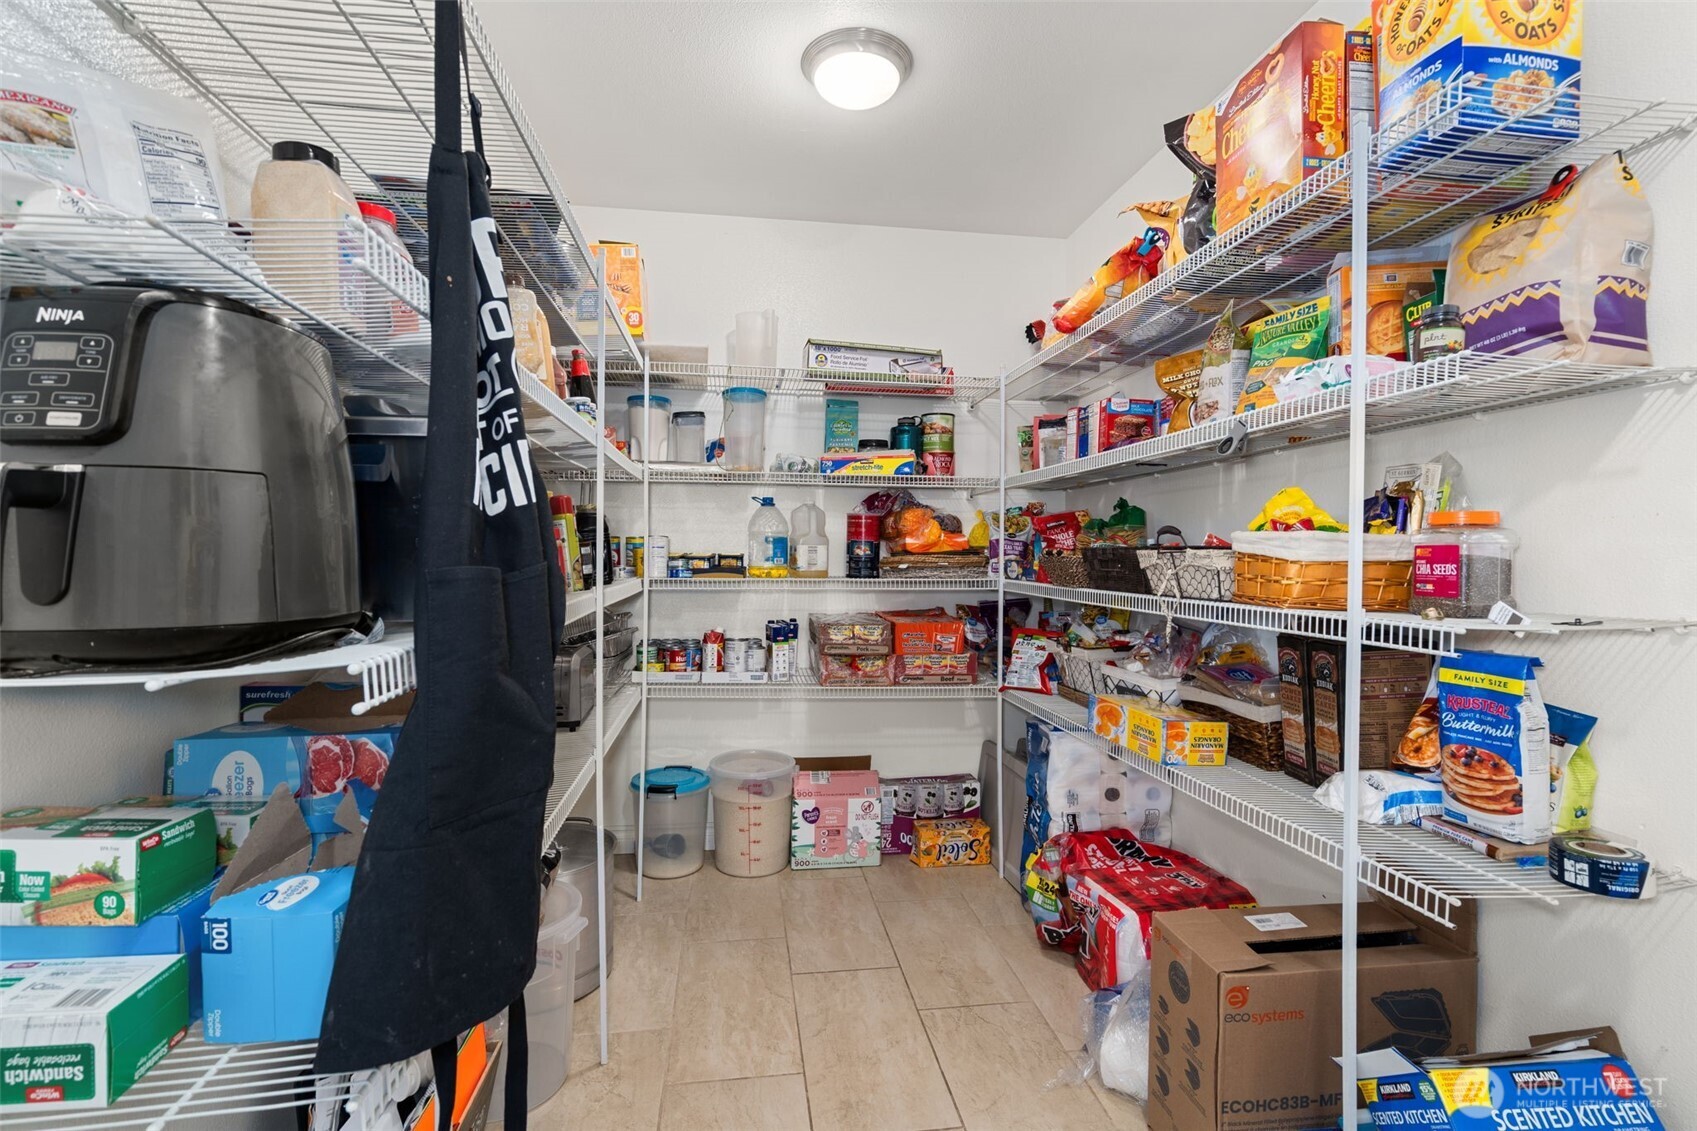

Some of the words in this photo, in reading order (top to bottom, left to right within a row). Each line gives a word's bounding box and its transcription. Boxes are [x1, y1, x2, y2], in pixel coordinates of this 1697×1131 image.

[1406, 16, 1442, 55] OATS
[1515, 18, 1557, 40] OATS
[1503, 53, 1559, 71] ALMONDS
[35, 306, 85, 325] NINJA
[628, 312, 639, 322] 30
[1264, 311, 1297, 327] FAMILY
[1297, 303, 1318, 316] SIZE
[1287, 315, 1316, 334] VALLEY
[1162, 373, 1184, 384] MILK
[1416, 563, 1431, 575] CHIA
[1433, 563, 1457, 575] SEEDS
[1282, 674, 1299, 685] KODIAK
[1316, 679, 1333, 692] KODIAK
[1454, 673, 1485, 684] FAMILY
[1488, 679, 1508, 689] SIZE
[245, 690, 291, 699] surefresh
[1133, 723, 1155, 736] ORANGES
[1442, 711, 1515, 739] Buttermilk
[1131, 729, 1156, 744] MANDARIN
[245, 776, 254, 796] Bags
[161, 819, 196, 841] Sandwich
[1432, 824, 1450, 834] PREMIUM
[936, 838, 981, 861] Soleil
[19, 873, 45, 886] Now
[1607, 884, 1639, 893] ORIGINAL
[102, 896, 117, 908] 90
[102, 907, 117, 915] Bags
[211, 921, 228, 951] 100
[214, 1009, 222, 1038] Double
[5, 1053, 30, 1067] bags
[33, 1053, 82, 1066] reclosable
[4, 1065, 84, 1085] Sandwich
[1511, 1071, 1560, 1082] KIRKLAND
[1602, 1071, 1616, 1091] 7
[1380, 1083, 1411, 1095] KIRKLAND
[1372, 1110, 1404, 1125] SCENTED
[1403, 1108, 1449, 1124] KITCHEN
[1491, 1105, 1574, 1131] SCENTED
[1573, 1102, 1654, 1129] KITCHEN
